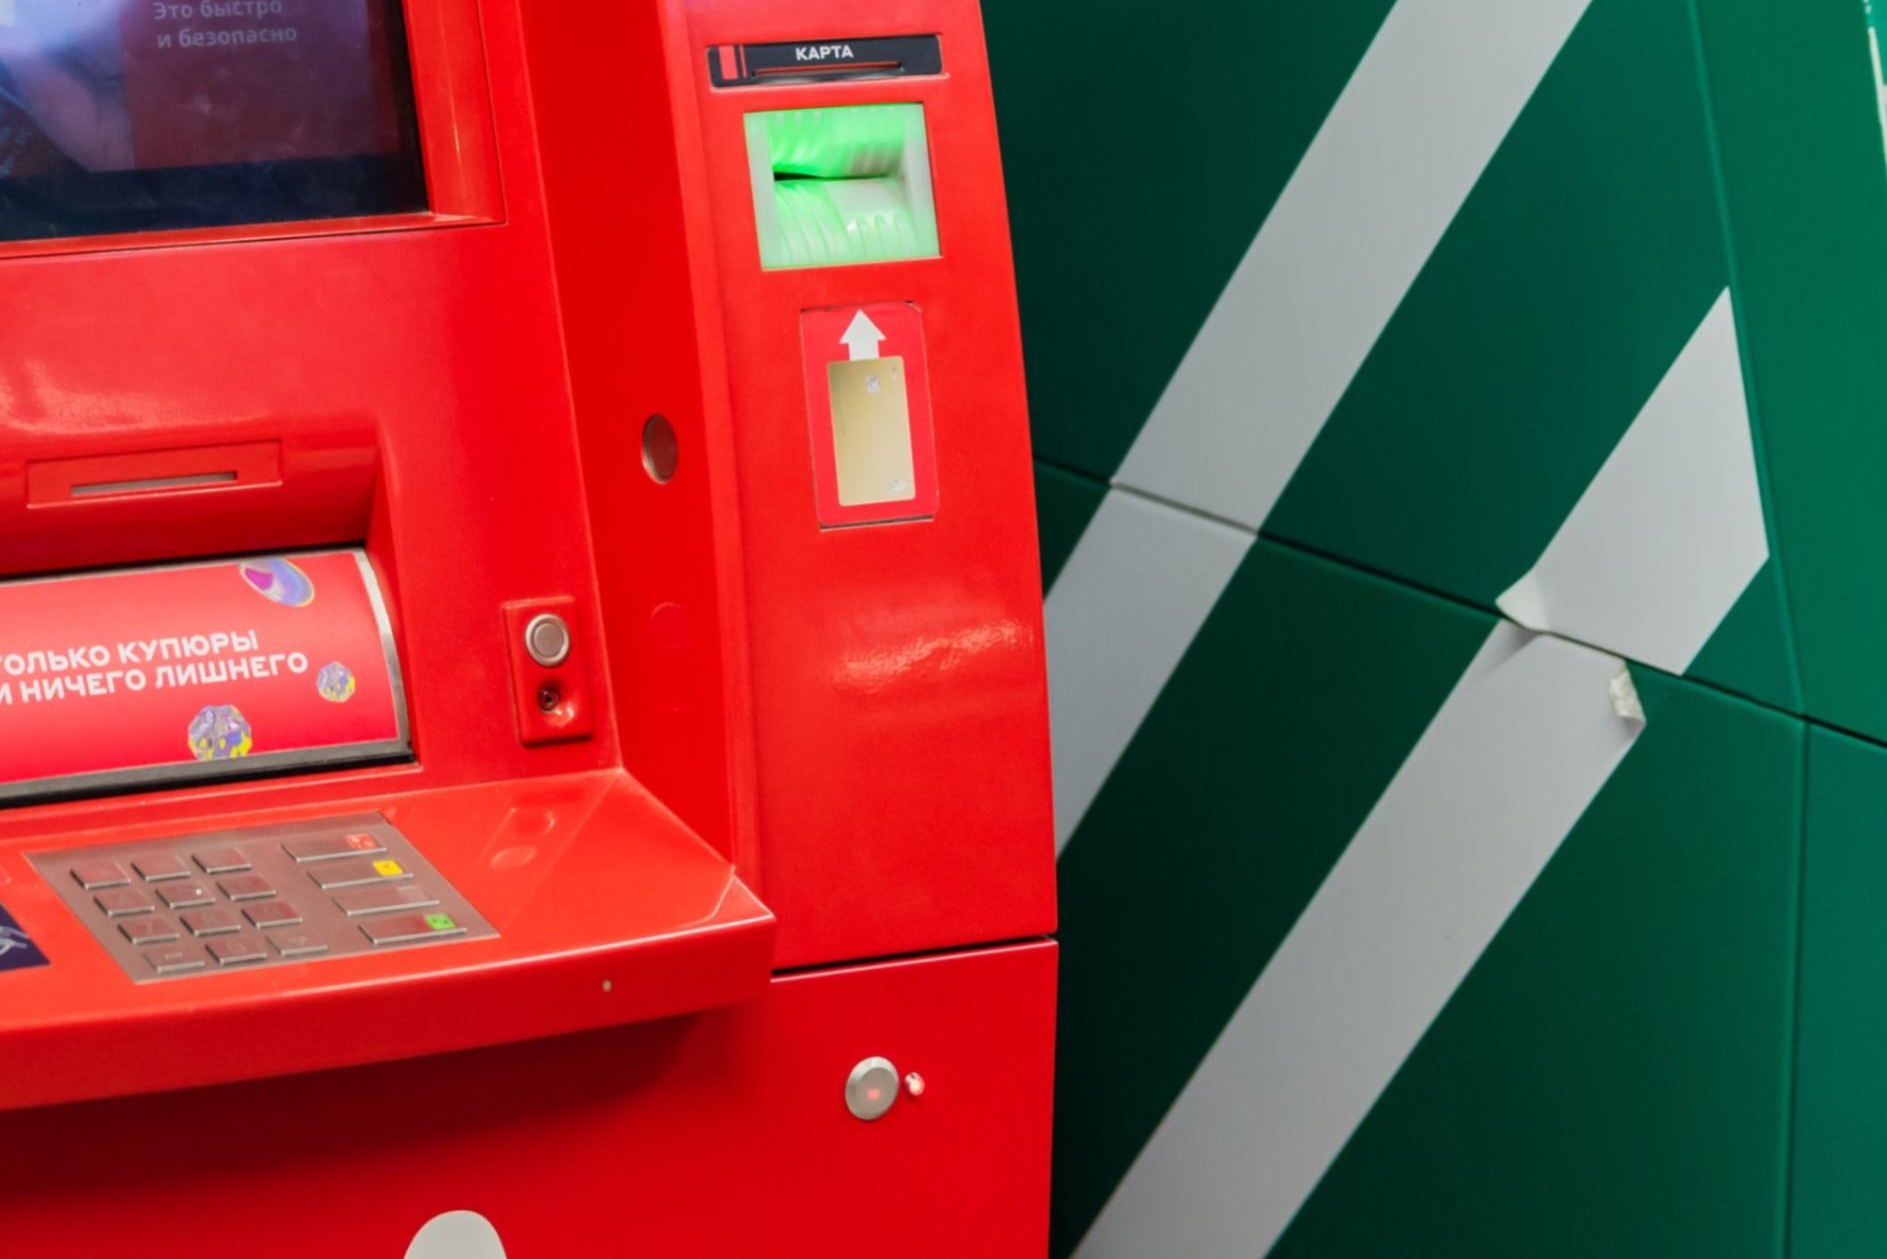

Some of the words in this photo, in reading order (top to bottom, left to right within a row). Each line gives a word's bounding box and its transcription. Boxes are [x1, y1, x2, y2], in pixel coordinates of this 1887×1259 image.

[152, 1, 194, 21] Это
[156, 33, 172, 49] и
[177, 26, 299, 48] безопасно
[794, 43, 855, 63] КАРТА
[117, 628, 259, 665] КУПЮРЫ
[19, 669, 147, 703] НИЧЕГО
[153, 651, 309, 691] ЛИШНЕГО
